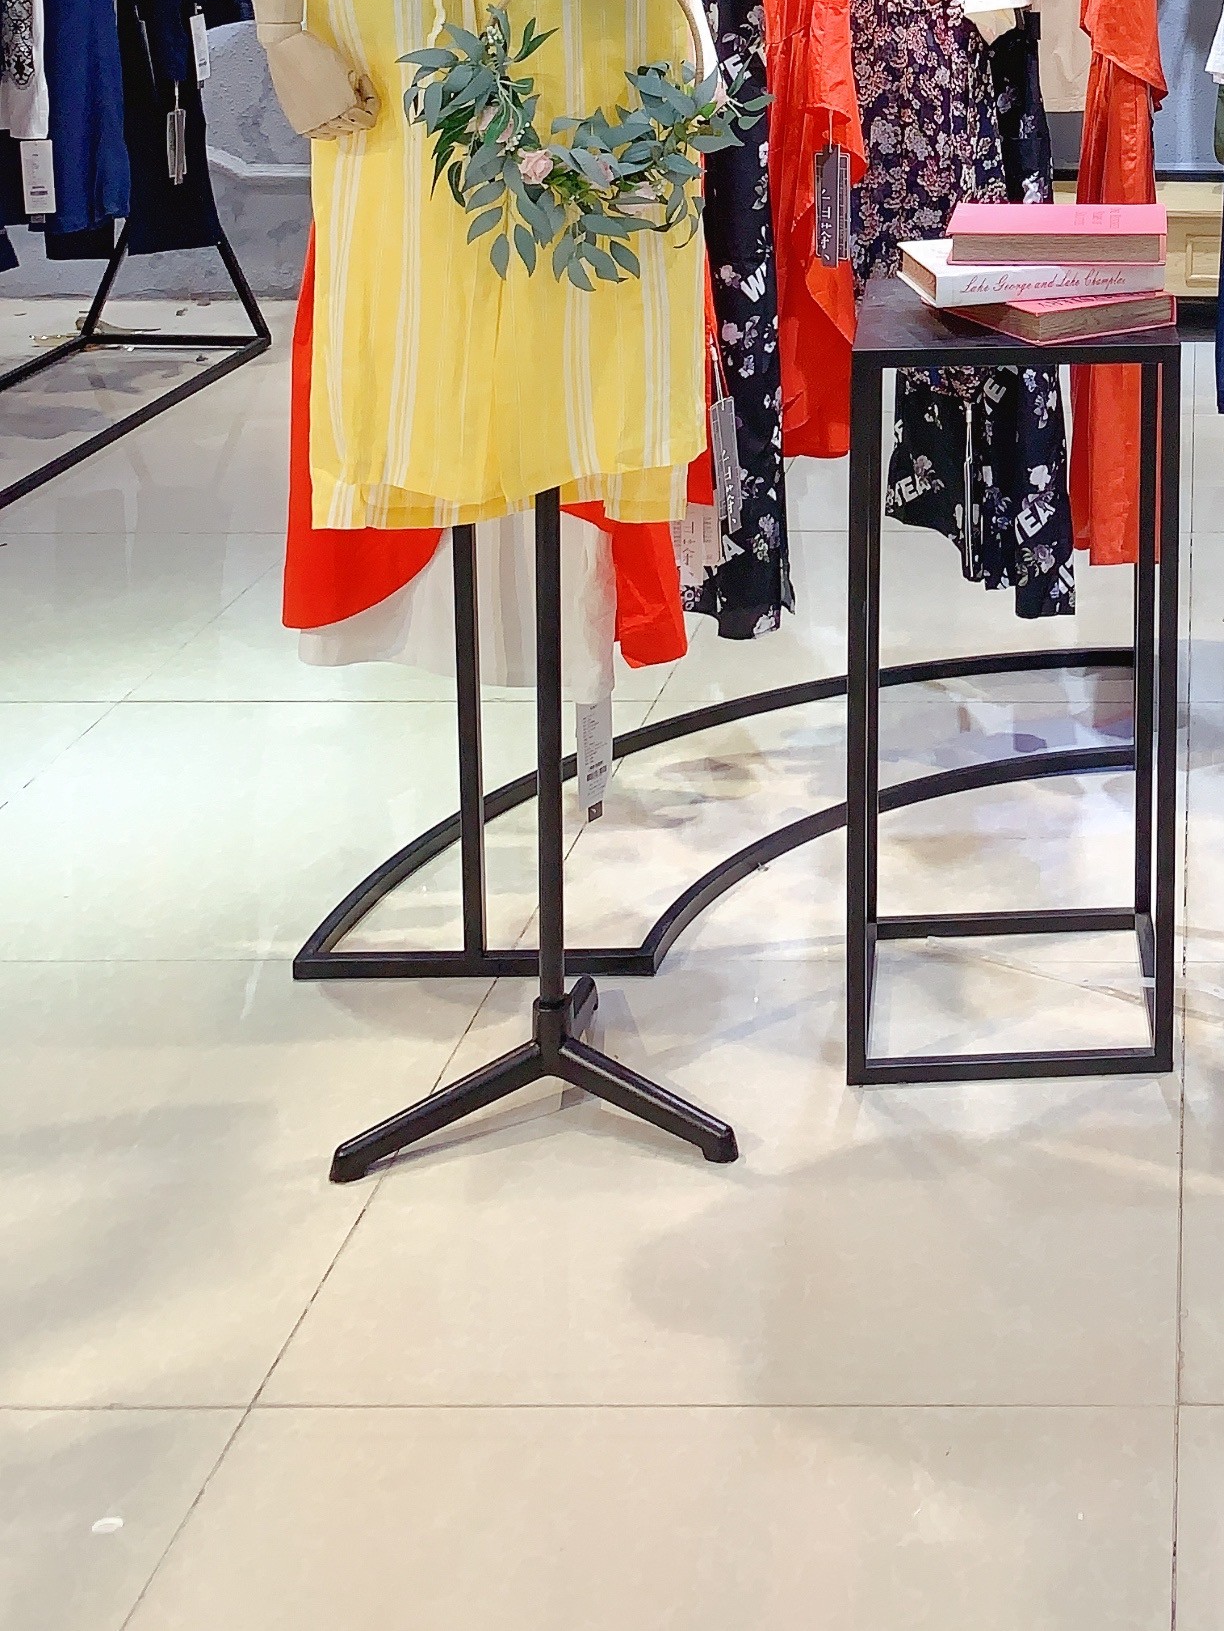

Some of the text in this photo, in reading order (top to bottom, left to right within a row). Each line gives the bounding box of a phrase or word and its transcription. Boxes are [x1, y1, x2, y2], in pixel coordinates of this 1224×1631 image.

[960, 275, 989, 294] Lake
[992, 274, 1032, 296] George
[1034, 273, 1058, 290] and
[1055, 269, 1080, 288] Lake
